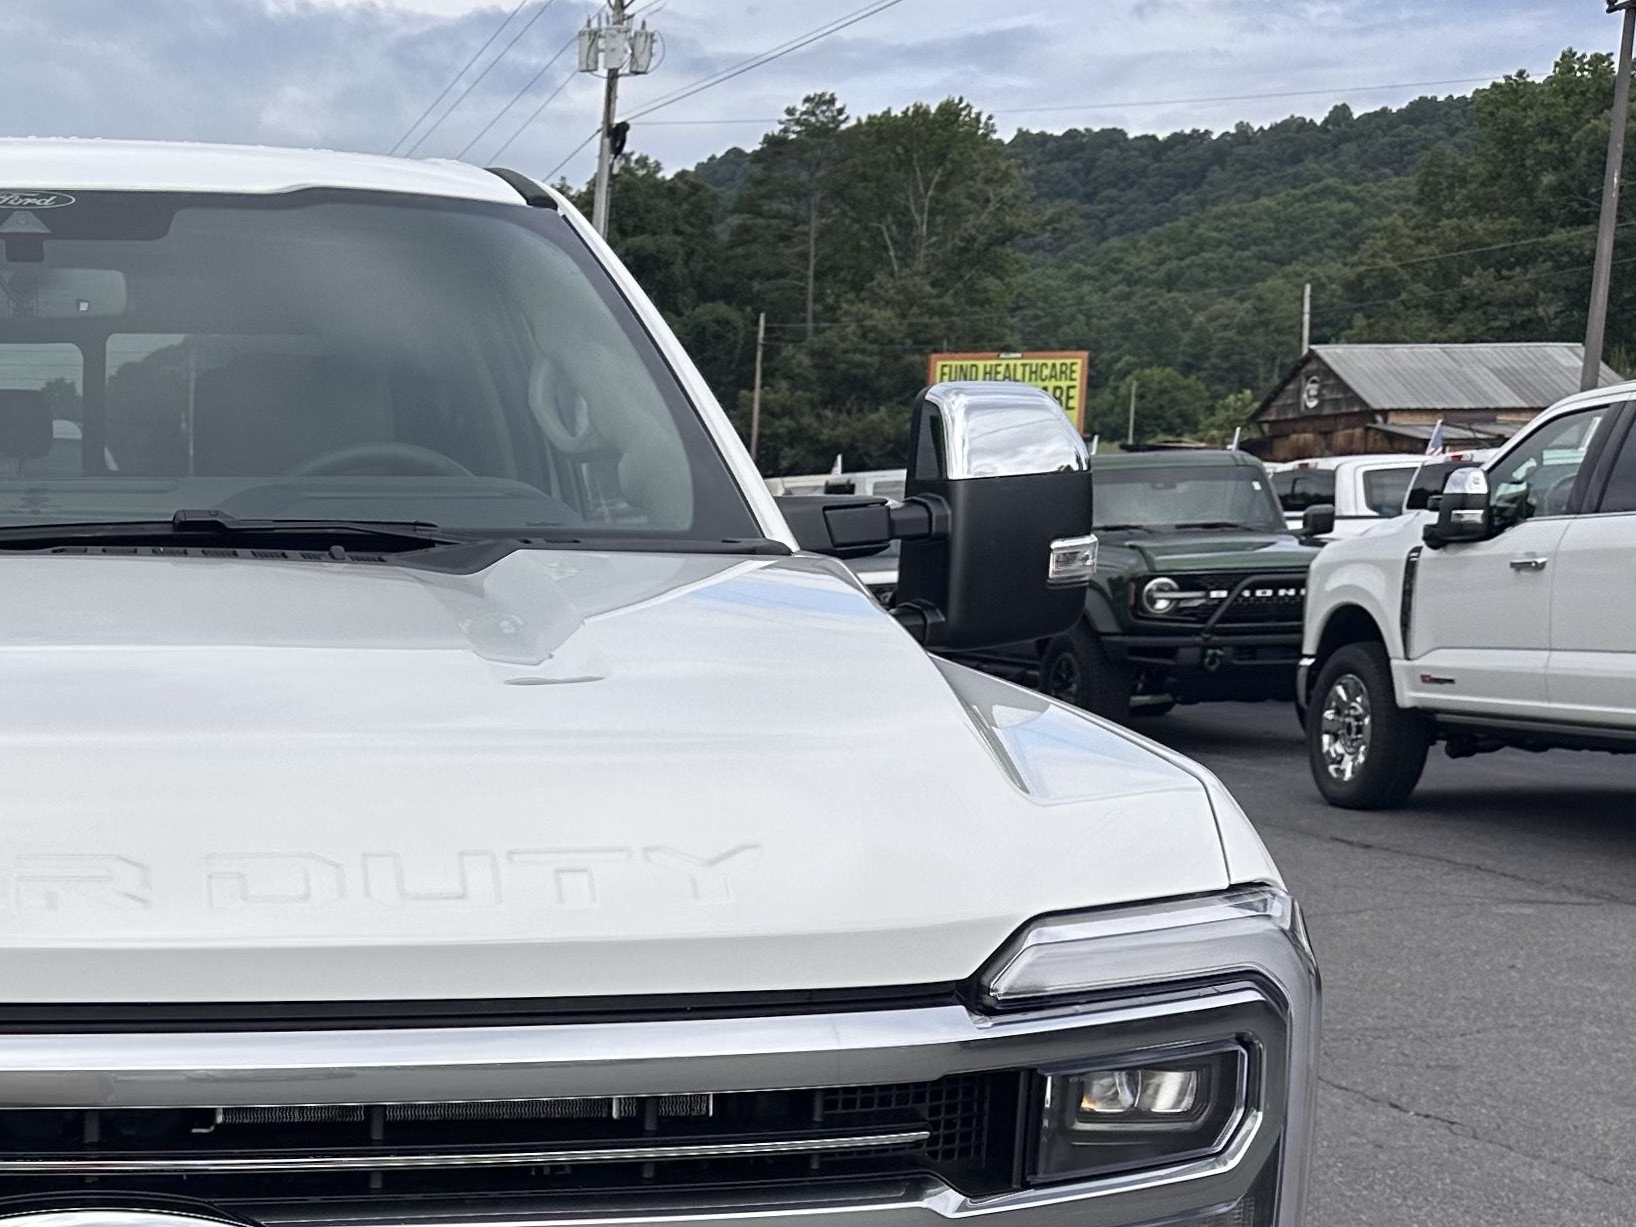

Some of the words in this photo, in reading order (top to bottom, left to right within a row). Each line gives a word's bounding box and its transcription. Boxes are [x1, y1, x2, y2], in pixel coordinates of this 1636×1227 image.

[939, 364, 979, 383] FUND
[983, 361, 1078, 383] HEALTHCARE
[204, 842, 765, 911] DUTY
